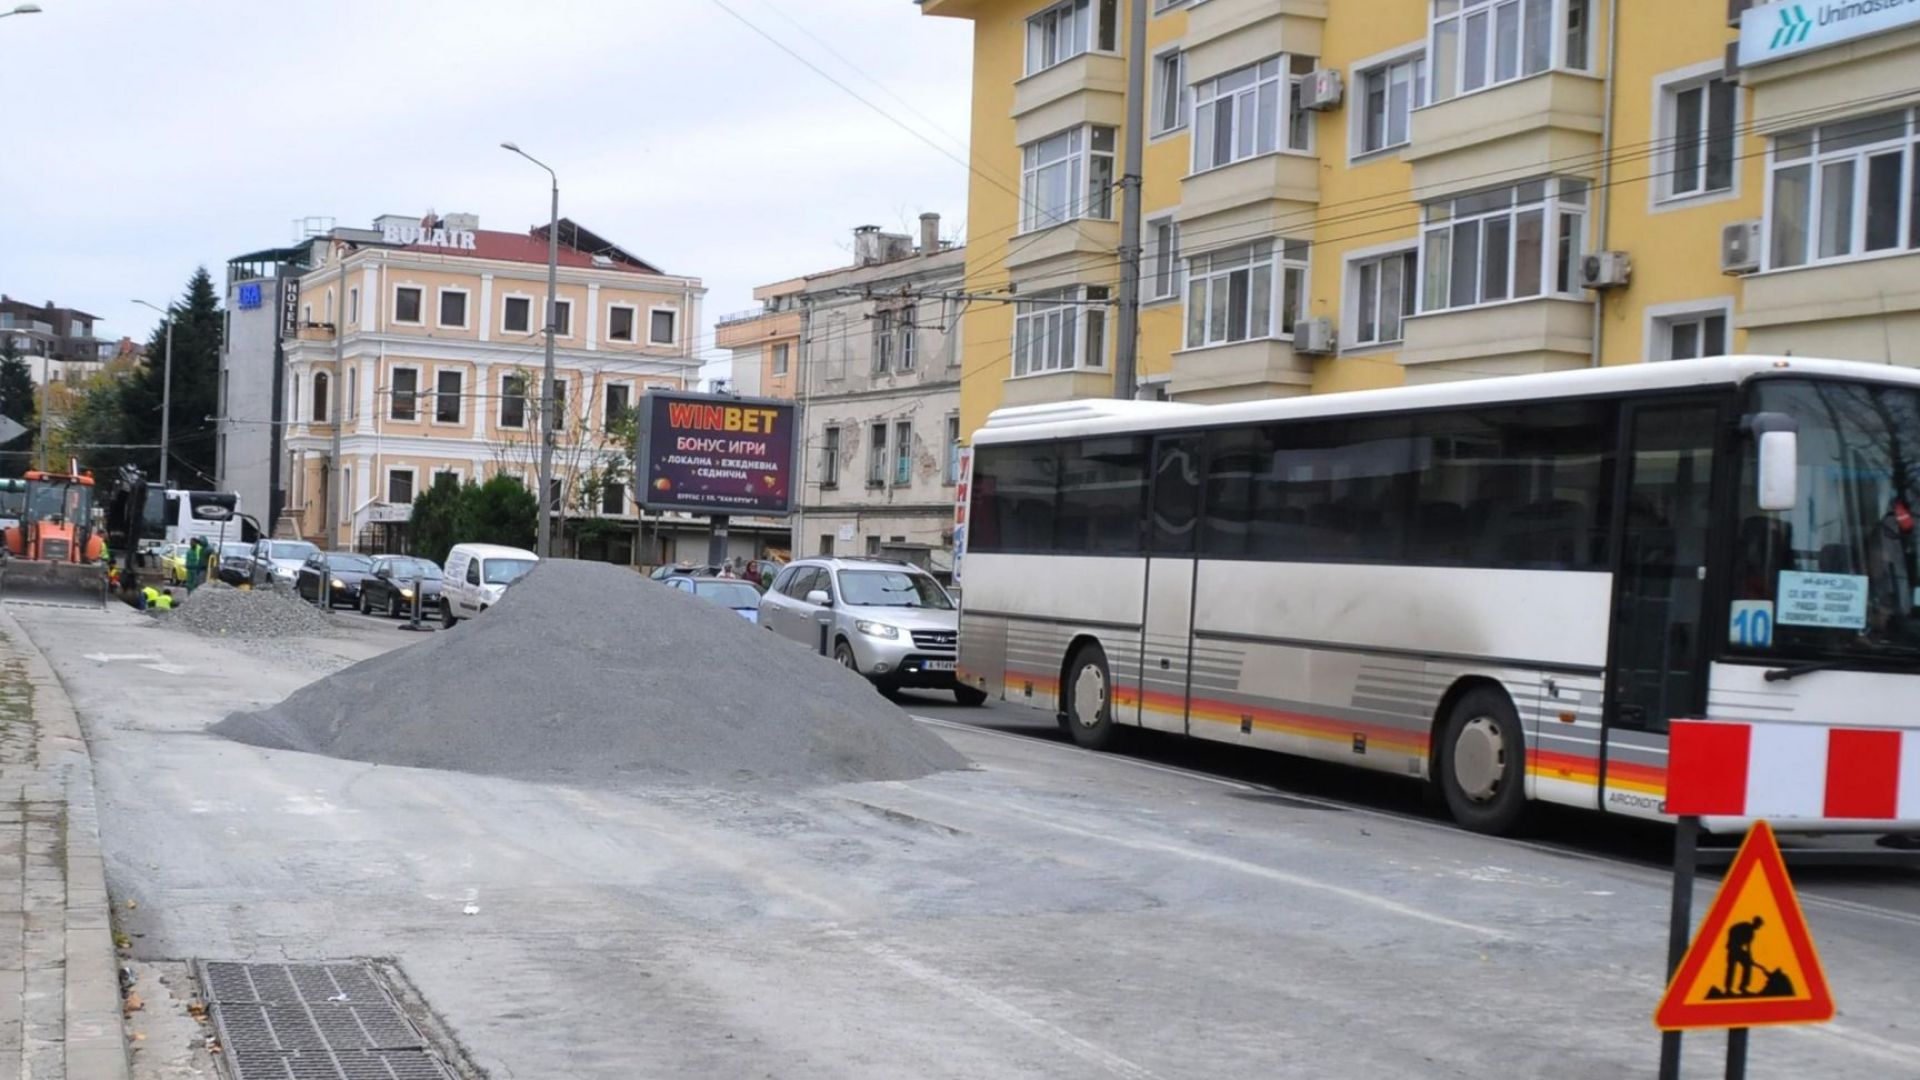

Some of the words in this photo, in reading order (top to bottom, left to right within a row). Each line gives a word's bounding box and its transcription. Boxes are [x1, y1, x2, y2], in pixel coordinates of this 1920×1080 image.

[1818, 0, 1916, 26] Unimaste
[382, 225, 477, 250] BULAIR
[286, 282, 298, 330] HOTEL
[669, 402, 778, 434] WINBET
[677, 437, 726, 453] БОНУС
[728, 440, 766, 455] ИГРИ
[668, 455, 712, 467] ЛОКАЛНА
[721, 458, 778, 471] ЕЖЕДНЕВНА
[697, 468, 748, 480] СЕДМИЧНА
[1733, 608, 1772, 648] 10
